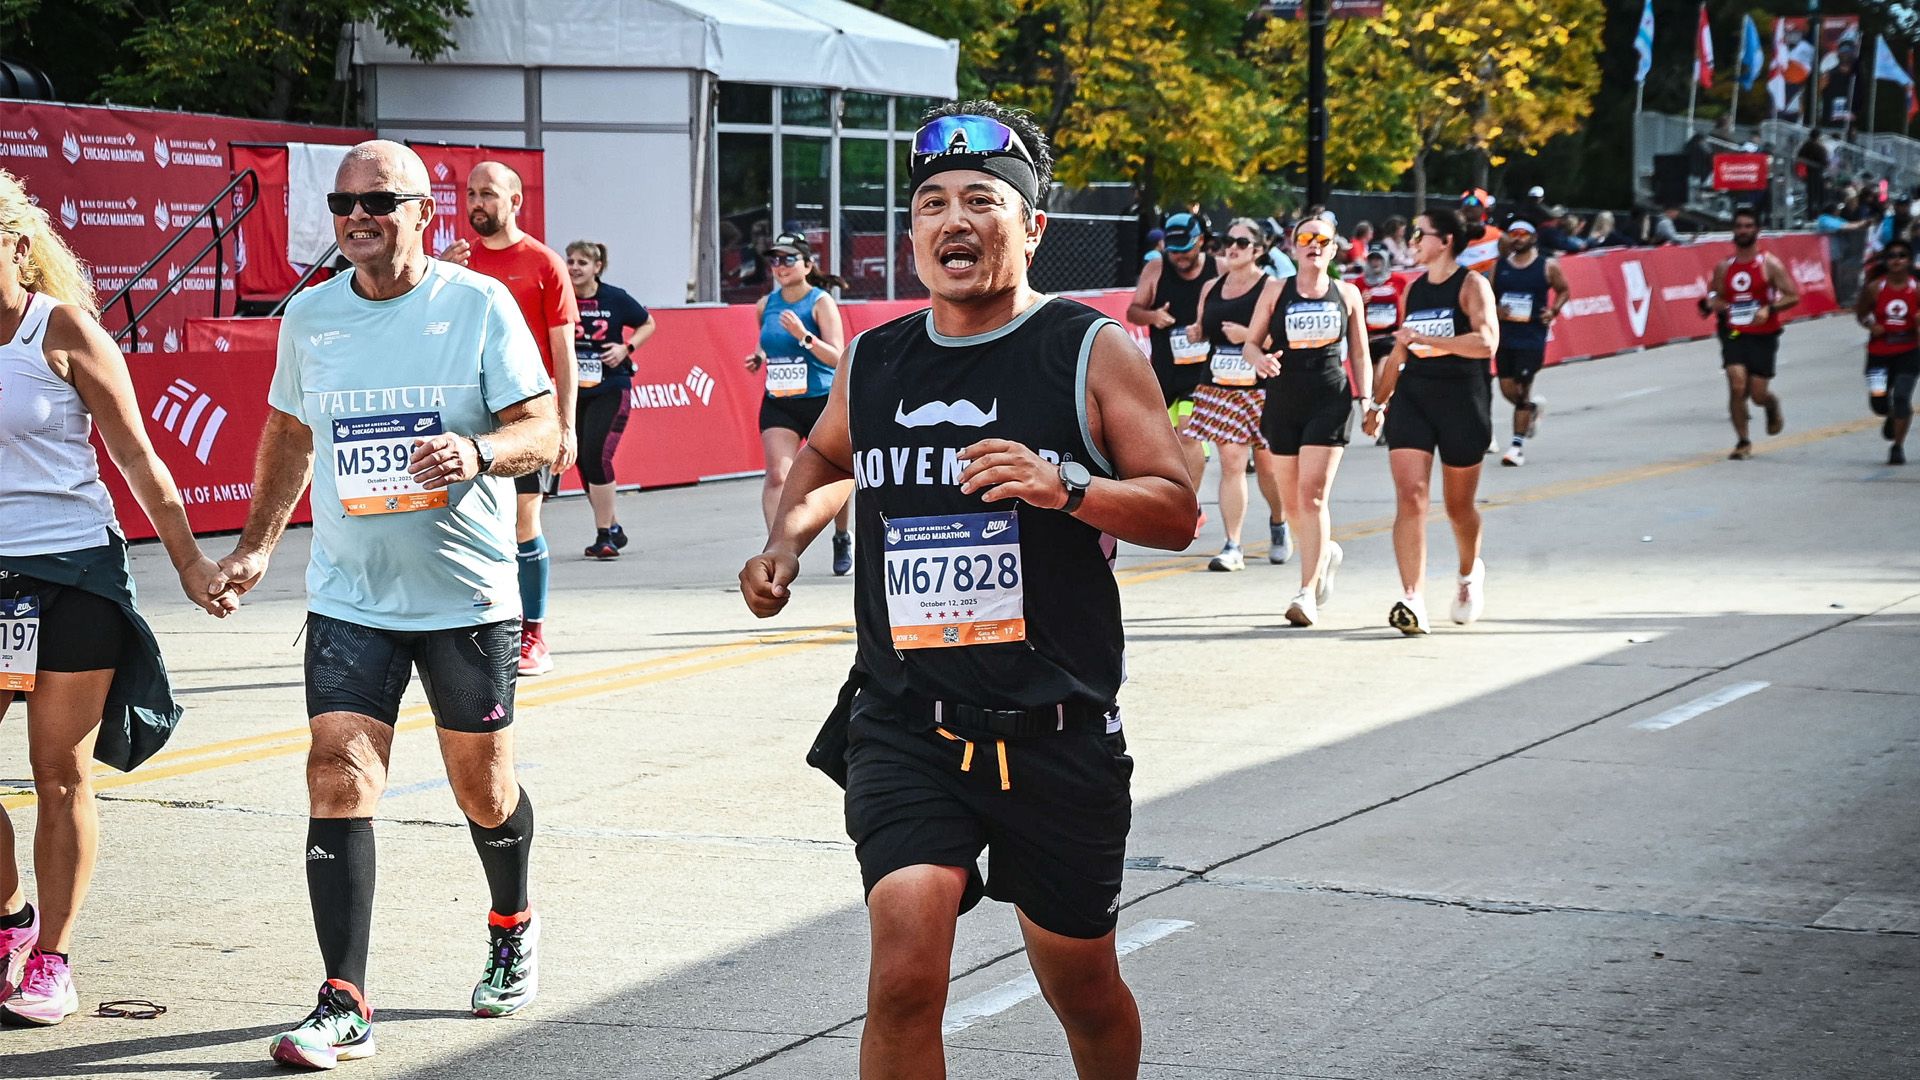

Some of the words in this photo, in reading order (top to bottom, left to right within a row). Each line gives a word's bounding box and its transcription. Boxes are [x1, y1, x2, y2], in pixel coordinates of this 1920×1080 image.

[10, 143, 48, 158] MARATHON
[83, 147, 109, 161] CHICAGO
[110, 149, 145, 162] MARATHON
[171, 151, 194, 165] CHICAGO
[82, 212, 109, 225] CHICAGO
[110, 214, 145, 226] MARATHON
[319, 387, 447, 414] VALENCIA
[631, 382, 691, 409] AMERICA
[351, 427, 374, 435] CHICAGO
[375, 425, 406, 434] MARATHON
[337, 443, 416, 476] M539
[853, 446, 1060, 490] MOVEM
[194, 486, 210, 503] OF
[213, 482, 255, 502] AMERI
[987, 520, 1008, 530] RUN
[904, 533, 931, 541] CHICAGO
[931, 531, 970, 540] MARATHON
[887, 552, 1019, 596] M67828
